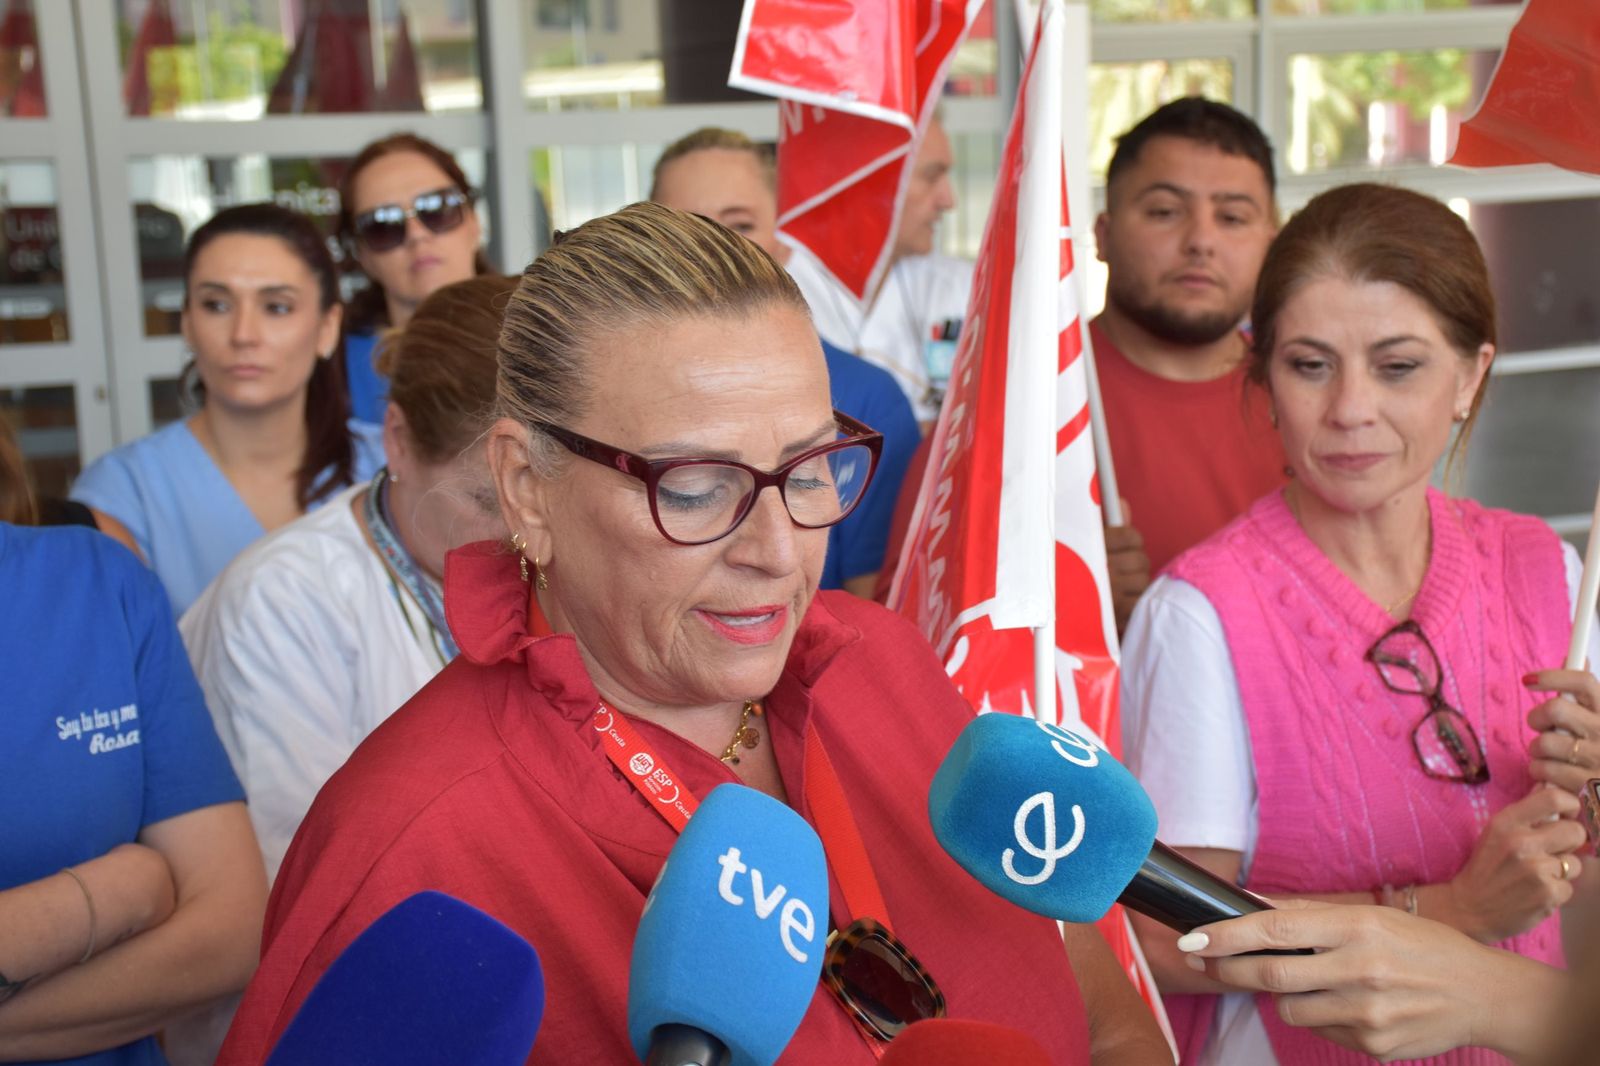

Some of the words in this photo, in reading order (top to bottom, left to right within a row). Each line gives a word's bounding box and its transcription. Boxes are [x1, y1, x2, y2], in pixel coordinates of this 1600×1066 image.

[89, 730, 140, 754] Rosa
[609, 728, 626, 747] Ceuta
[634, 754, 653, 771] UGT
[718, 847, 815, 963] tve
